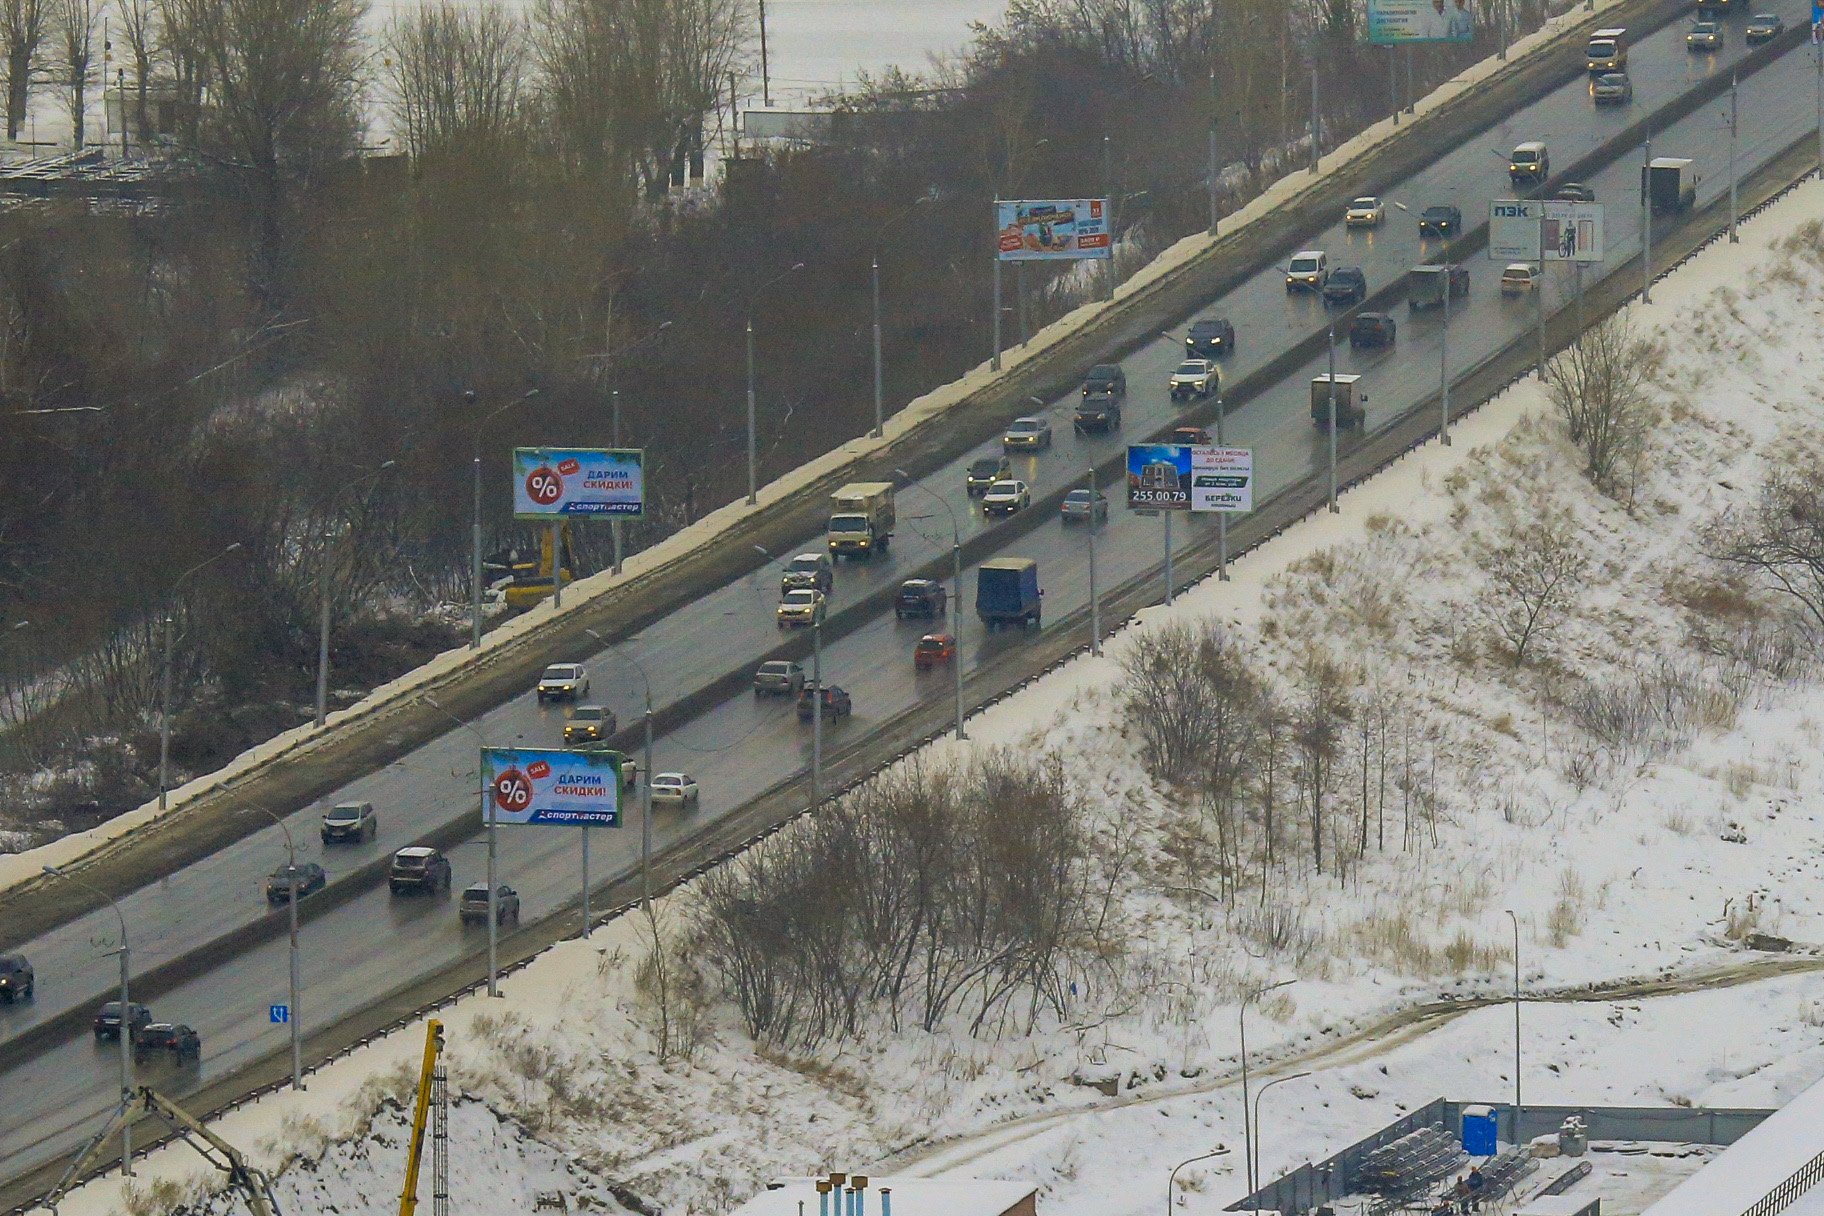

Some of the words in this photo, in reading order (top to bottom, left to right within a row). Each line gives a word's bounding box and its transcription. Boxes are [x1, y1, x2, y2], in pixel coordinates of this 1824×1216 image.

[1494, 206, 1528, 217] ПЭК
[587, 470, 629, 480] ДАРИМ
[583, 480, 633, 490] СКИДКИ!
[1132, 490, 1187, 501] 255.00.79
[530, 764, 547, 774] SALE
[558, 774, 602, 785] ДАРИМ
[554, 785, 606, 796] СКИДКИ!
